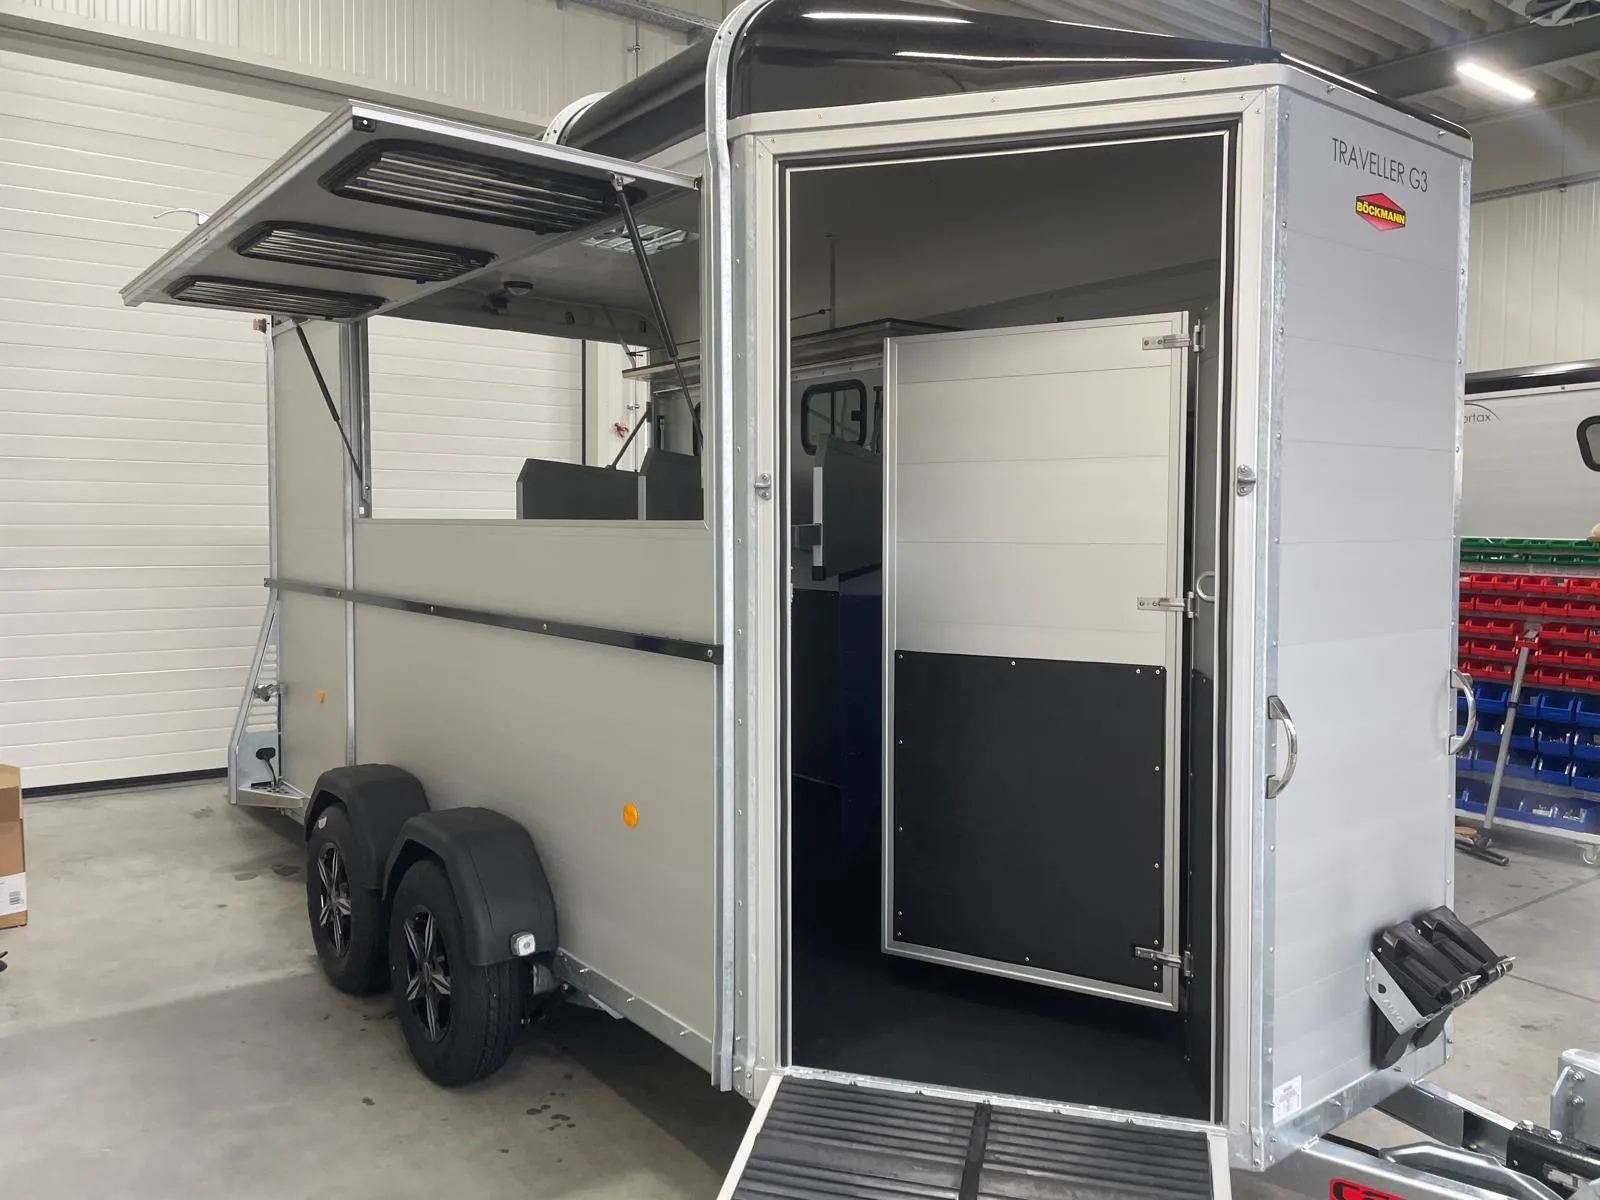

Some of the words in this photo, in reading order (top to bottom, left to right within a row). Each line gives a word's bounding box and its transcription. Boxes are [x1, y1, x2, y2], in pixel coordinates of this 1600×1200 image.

[1332, 137, 1405, 185] TRAVELLER
[1409, 167, 1428, 193] G3
[1356, 201, 1405, 225] BÖCKMANN
[1463, 411, 1491, 424] ortax
